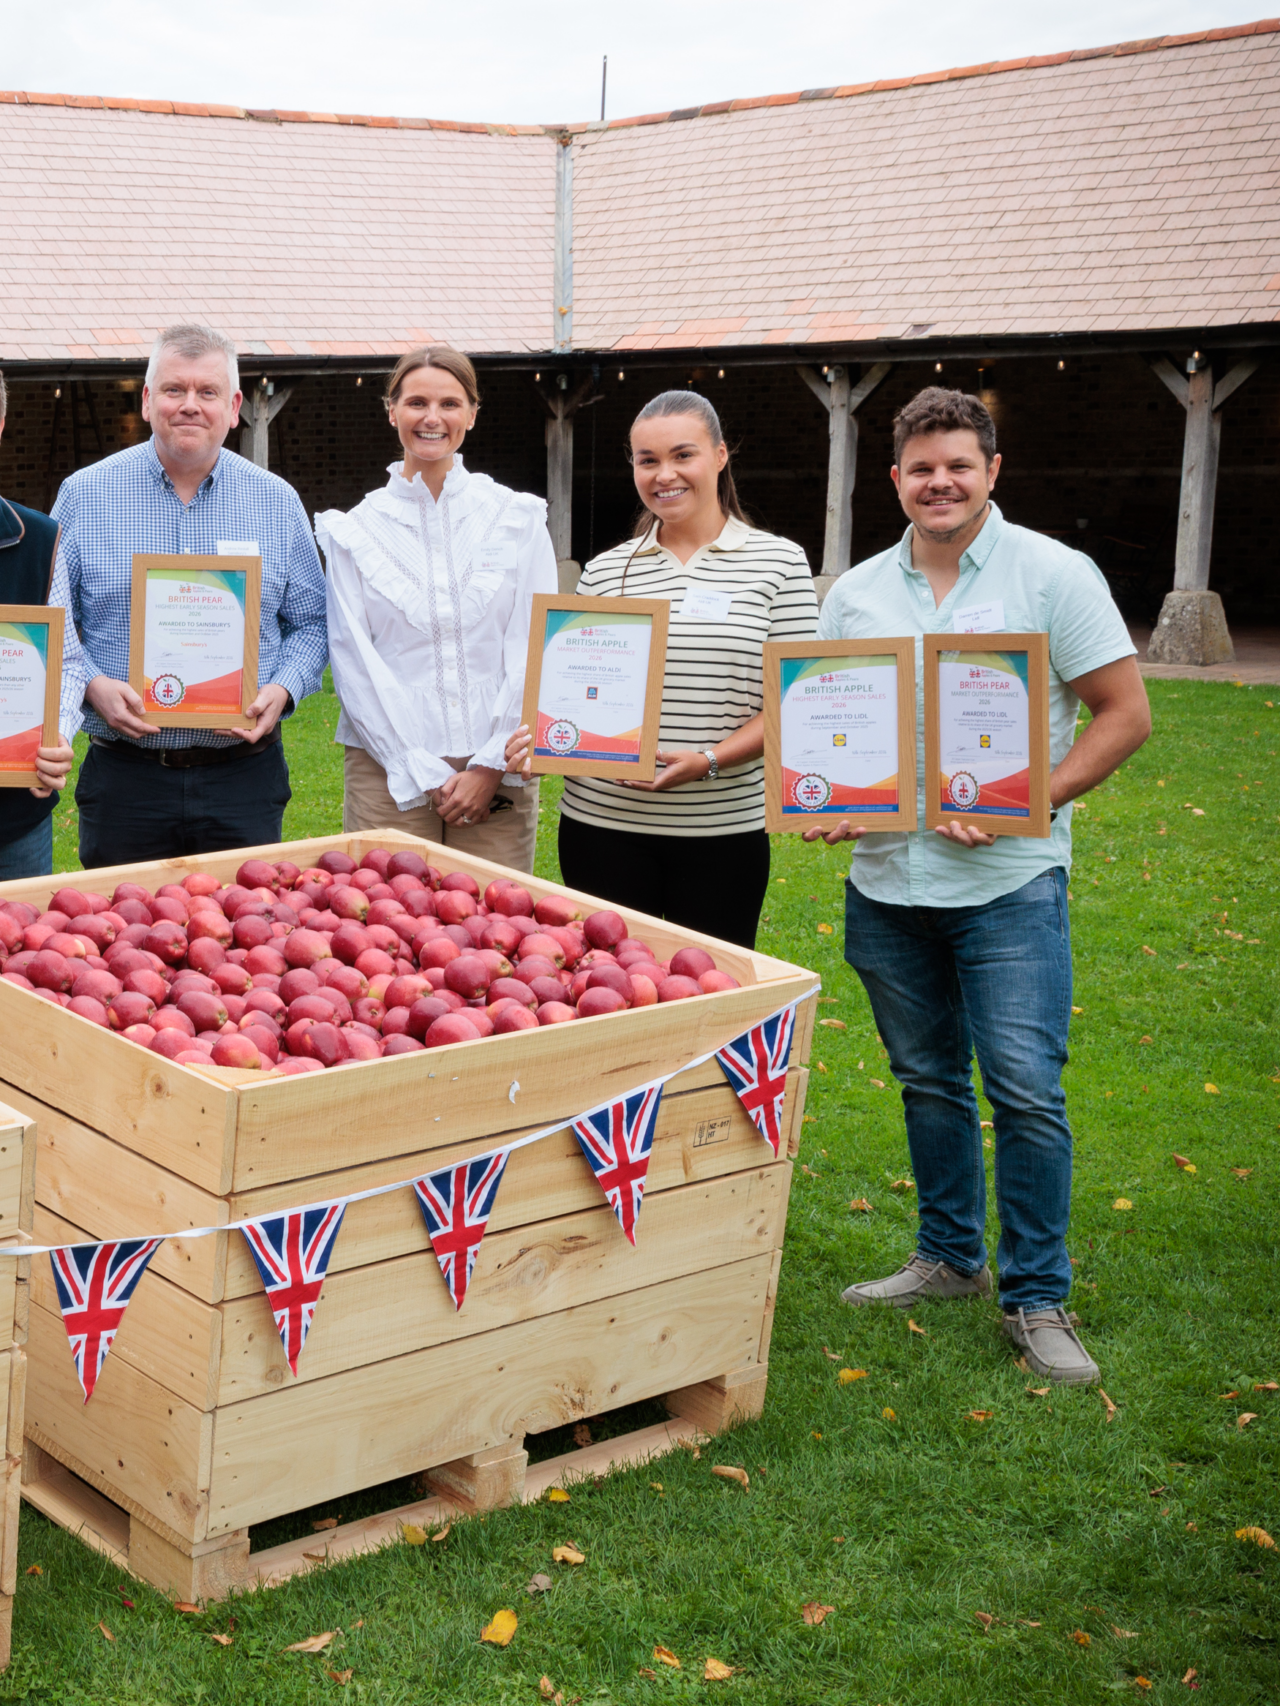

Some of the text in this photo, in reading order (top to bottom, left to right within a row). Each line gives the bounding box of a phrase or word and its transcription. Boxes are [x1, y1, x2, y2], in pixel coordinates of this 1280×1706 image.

[566, 638, 628, 648] BRITISH APPLE
[581, 647, 635, 655] OUTPERFORMANCE
[805, 684, 873, 694] BRITISH APPLE
[960, 681, 1010, 690] BRITISH PEAR
